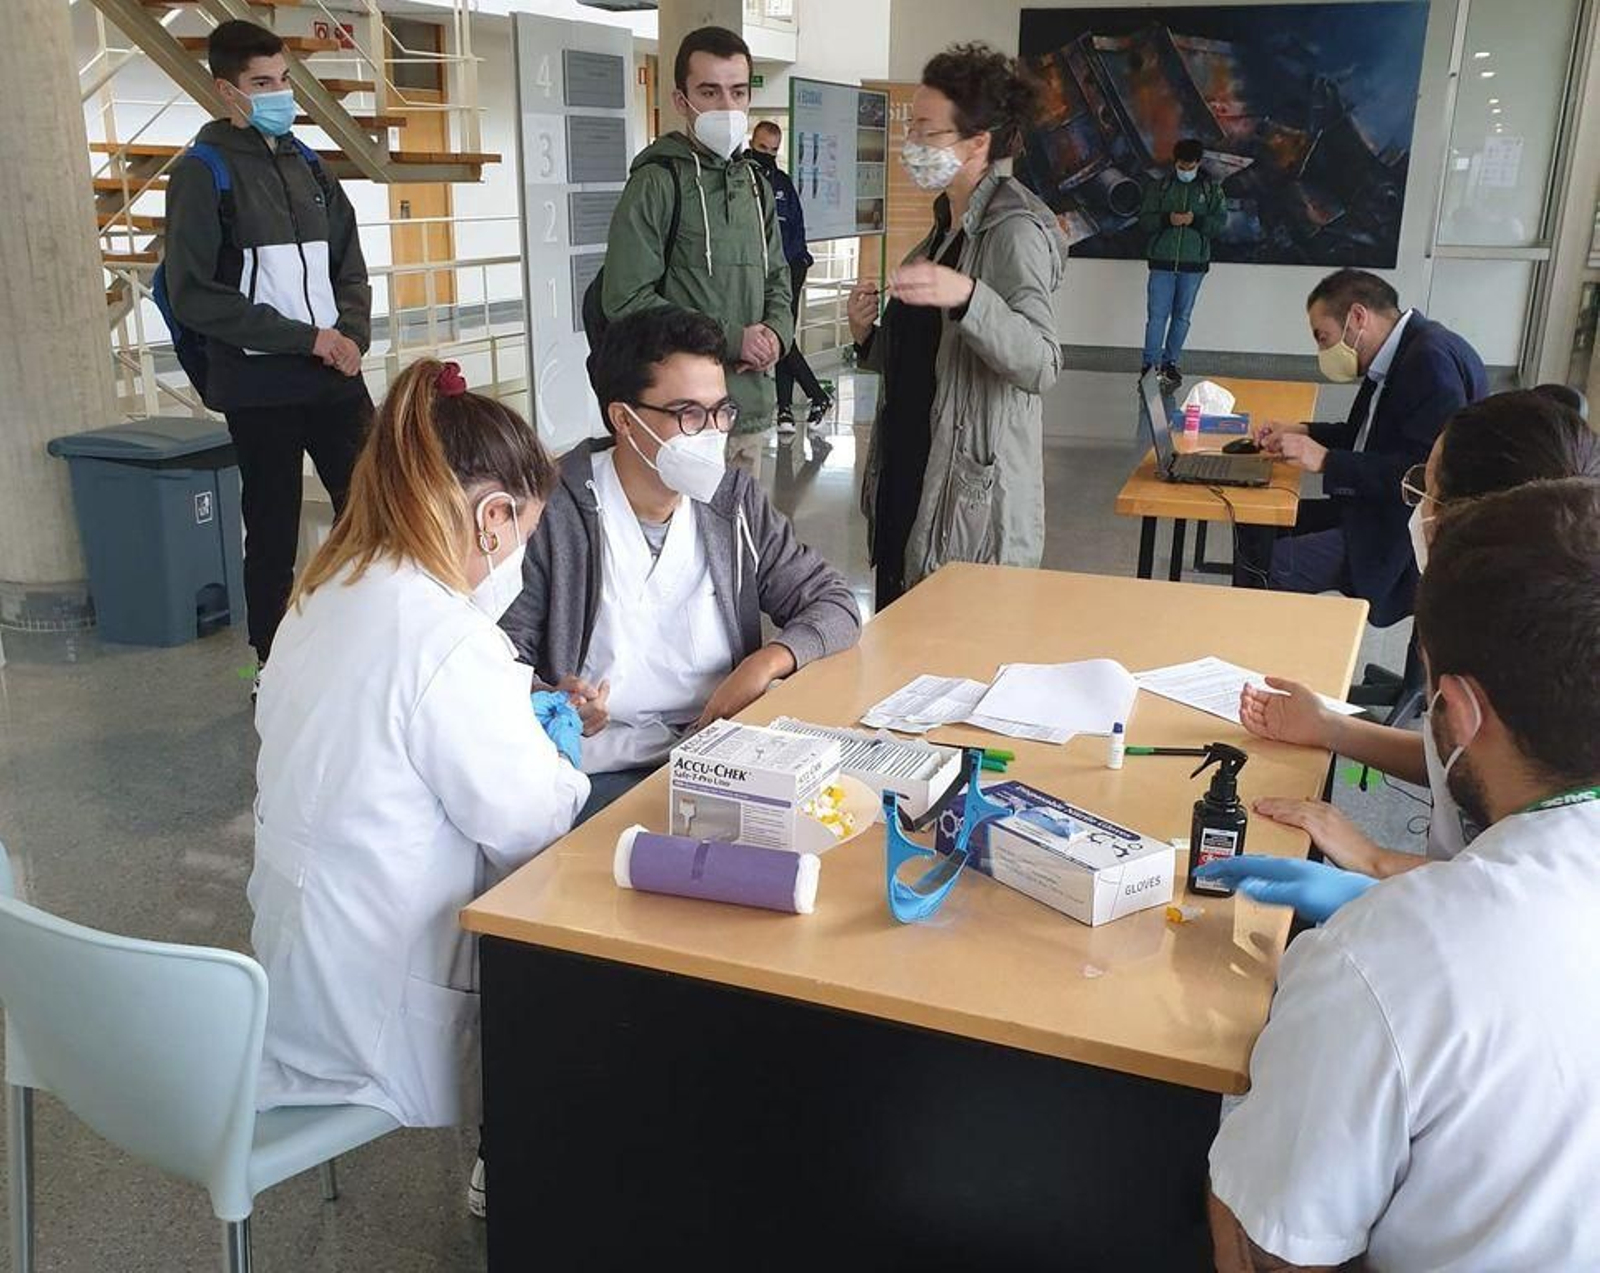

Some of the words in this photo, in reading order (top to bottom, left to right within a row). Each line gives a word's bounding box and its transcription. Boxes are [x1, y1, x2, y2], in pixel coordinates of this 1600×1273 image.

[535, 54, 552, 98] 4
[539, 132, 554, 178] 3
[543, 200, 558, 242] 2
[546, 277, 557, 319] 1
[674, 757, 747, 781] ACCU-CHEK
[1124, 875, 1161, 895] GLOVES
